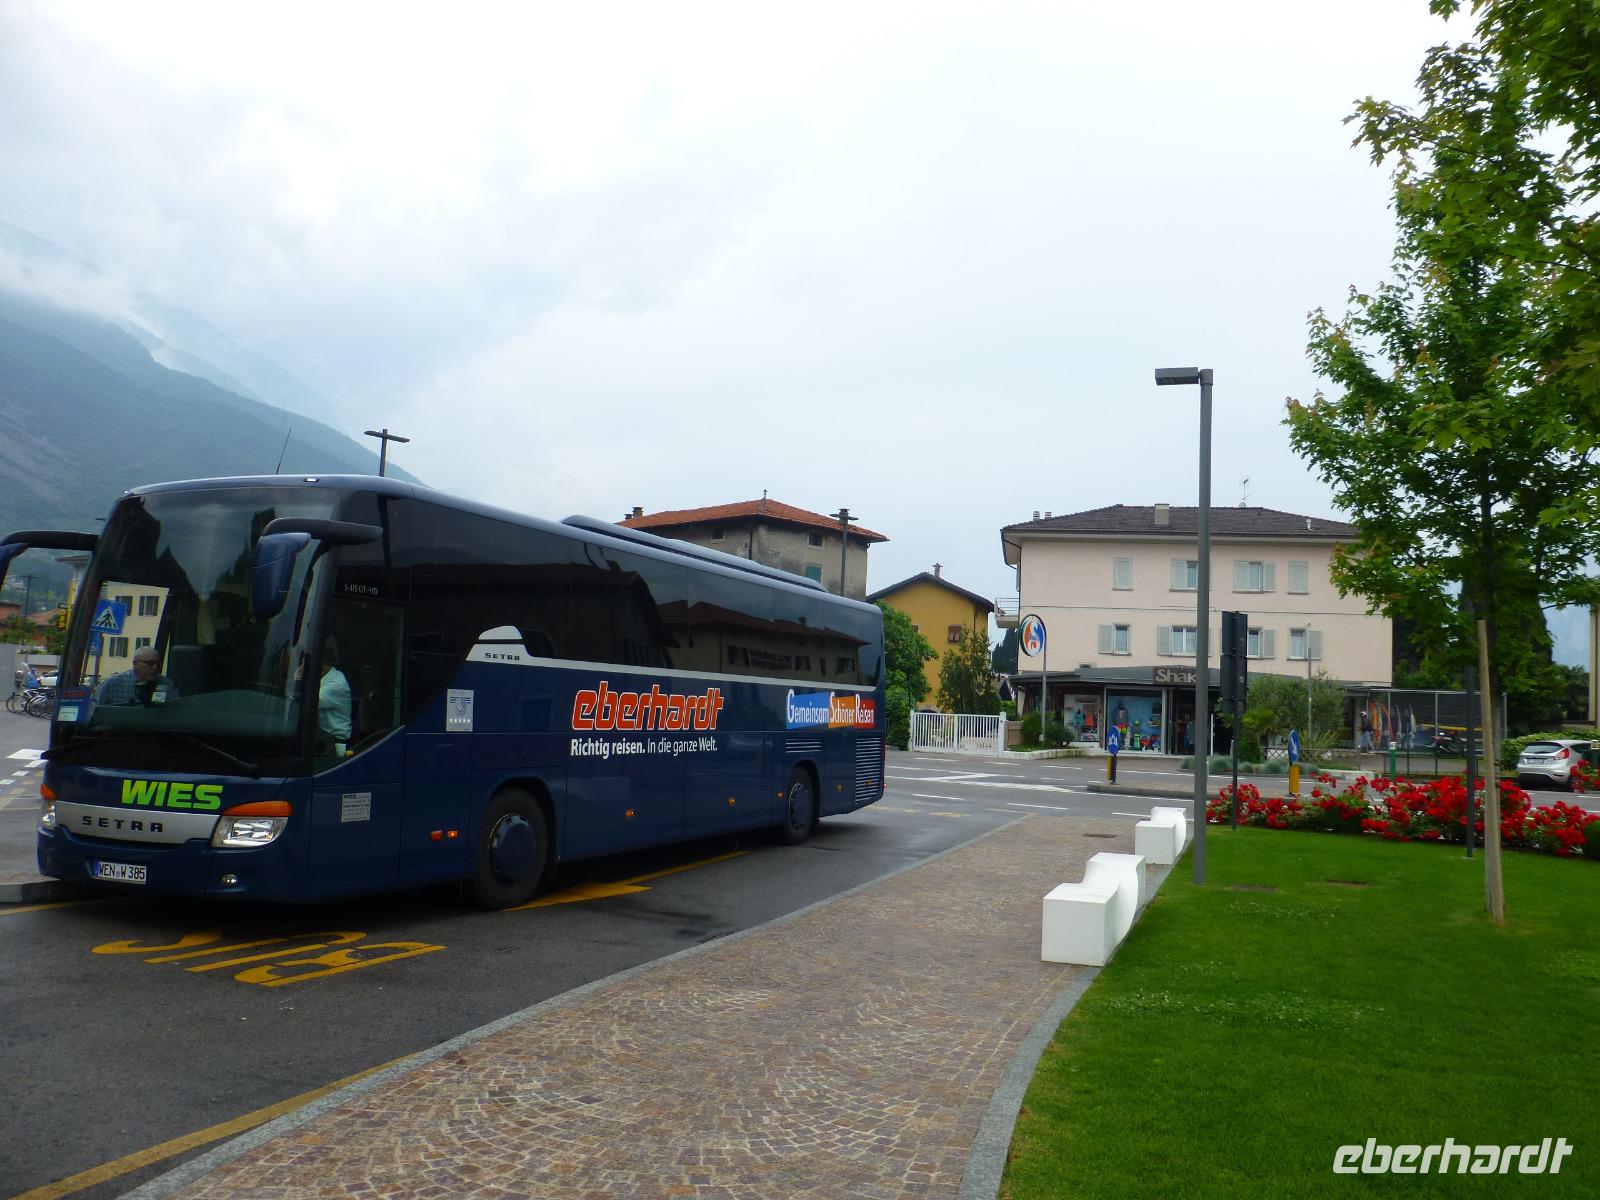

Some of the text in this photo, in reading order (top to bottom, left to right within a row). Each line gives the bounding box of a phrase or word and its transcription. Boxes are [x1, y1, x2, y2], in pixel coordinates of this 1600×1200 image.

[485, 652, 520, 660] SETRA
[572, 681, 724, 730] eberhardt
[787, 689, 874, 723] Gemeinsam Schöner Reisen
[571, 736, 718, 759] Richtig reisen. In die ganze Welt.
[121, 779, 223, 810] WIES
[82, 816, 163, 832] SETRA
[128, 867, 146, 880] 385
